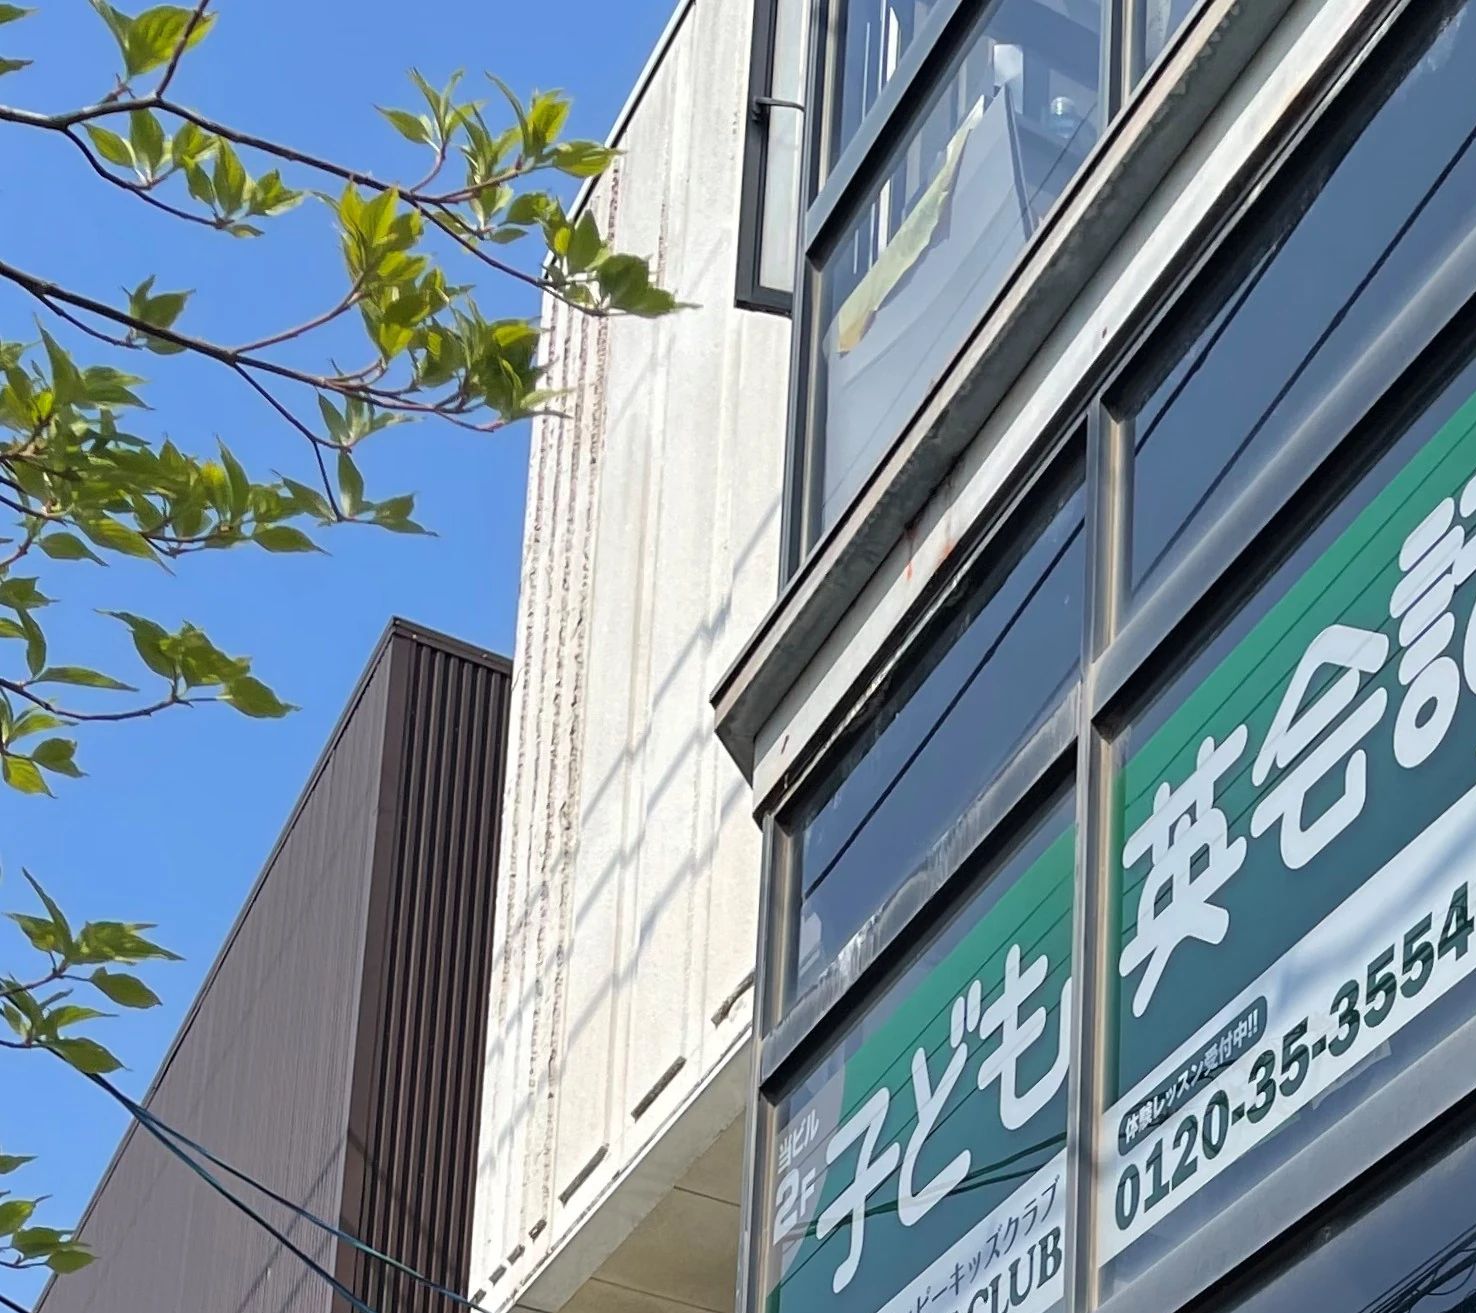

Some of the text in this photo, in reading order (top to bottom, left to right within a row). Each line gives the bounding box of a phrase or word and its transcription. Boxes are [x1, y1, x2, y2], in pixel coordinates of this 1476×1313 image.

[777, 1108, 820, 1175] 当ビル
[816, 943, 1071, 1294] 子ども
[1114, 881, 1475, 1231] 0120-35-3554
[772, 1167, 817, 1246] 2F
